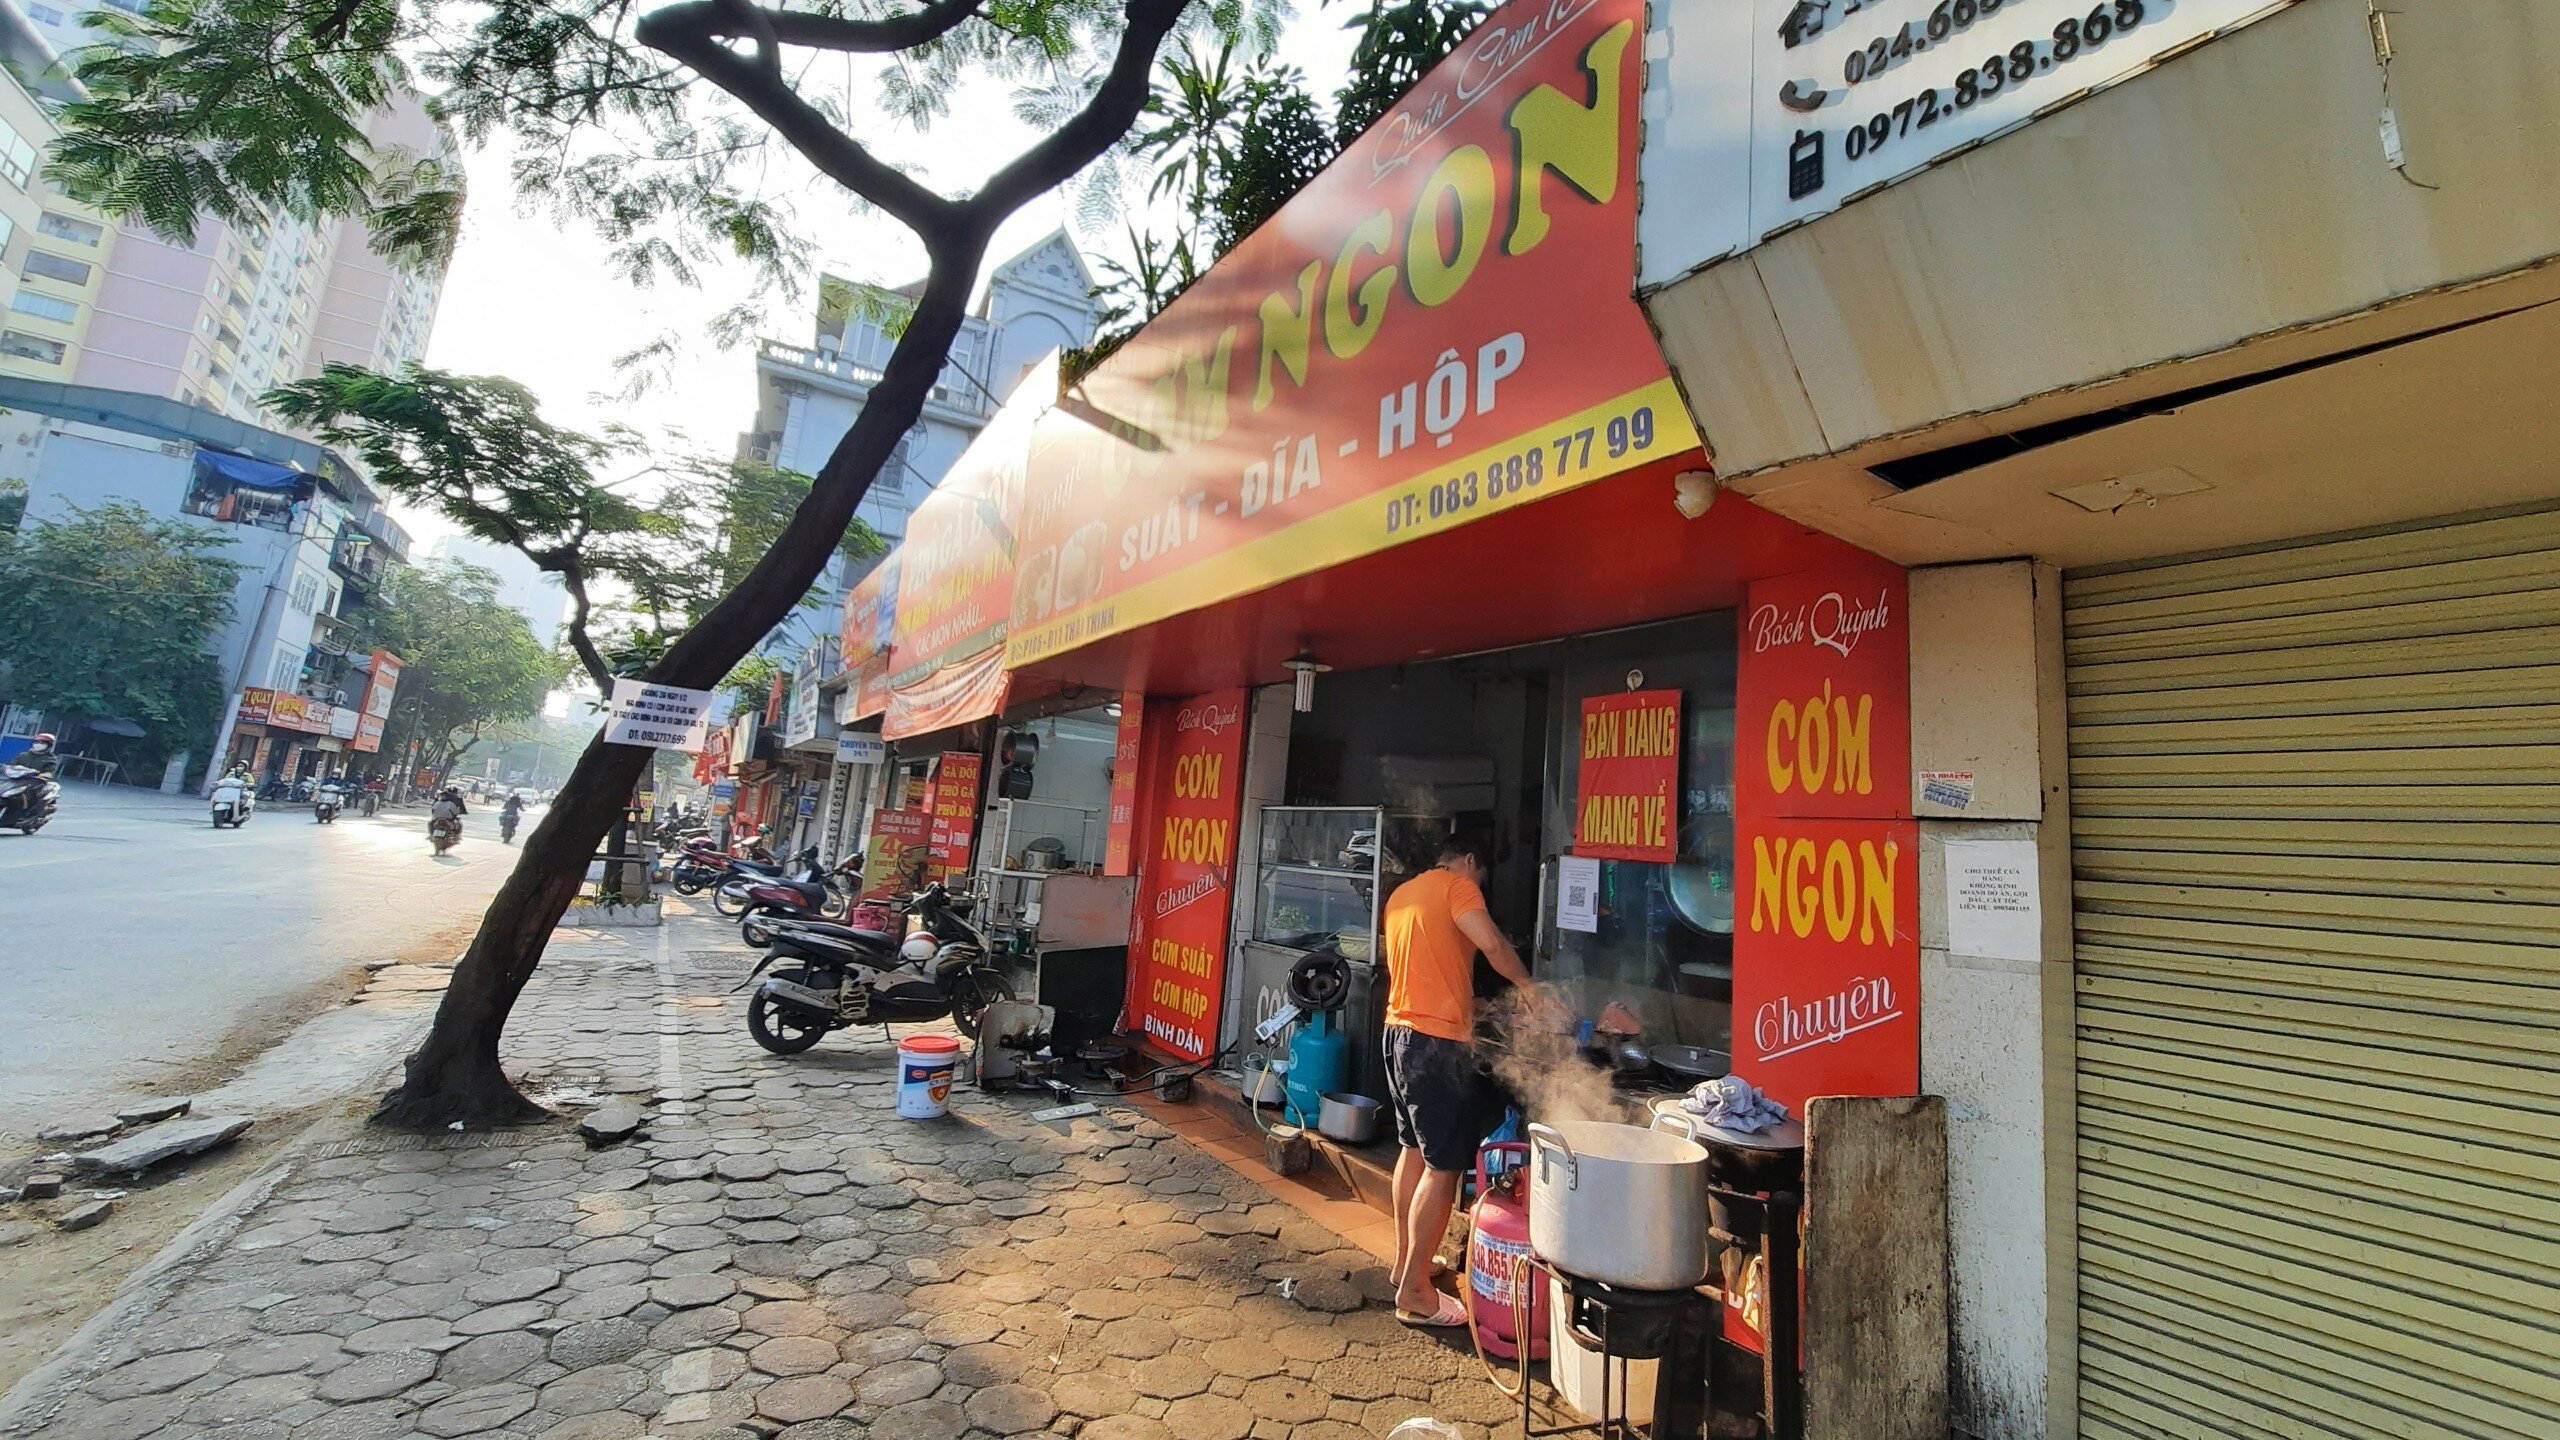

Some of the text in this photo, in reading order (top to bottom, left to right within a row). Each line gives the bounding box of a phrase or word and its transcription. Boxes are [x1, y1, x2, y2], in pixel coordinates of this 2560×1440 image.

[1845, 0, 2144, 161] 0972.838.868
[1252, 19, 1633, 412] NGON
[1118, 485, 1206, 571] SUẤT
[1240, 435, 1322, 519] ĐĨA
[1378, 331, 1526, 459] HỘP
[1387, 406, 1654, 534] ĐT: 083 888 77 99
[1748, 587, 1889, 658] Bách Quỳnh
[1584, 697, 1675, 760] BÁN HÀNG
[1766, 677, 1874, 796] CƠM
[943, 764, 957, 779] GÀ
[960, 782, 975, 798] GÀ
[1175, 744, 1223, 800] CƠM
[1161, 816, 1228, 867] NGON
[1583, 778, 1668, 847] MANG VỀ
[1156, 872, 1216, 914] Chuyên
[1750, 835, 1899, 949] NGON
[1152, 937, 1214, 980] CƠM SUẤT
[1144, 1009, 1205, 1057] BÌNH DÂN
[1152, 977, 1208, 1024] CƠM HỘP
[1753, 975, 1897, 1052] Chuyên
